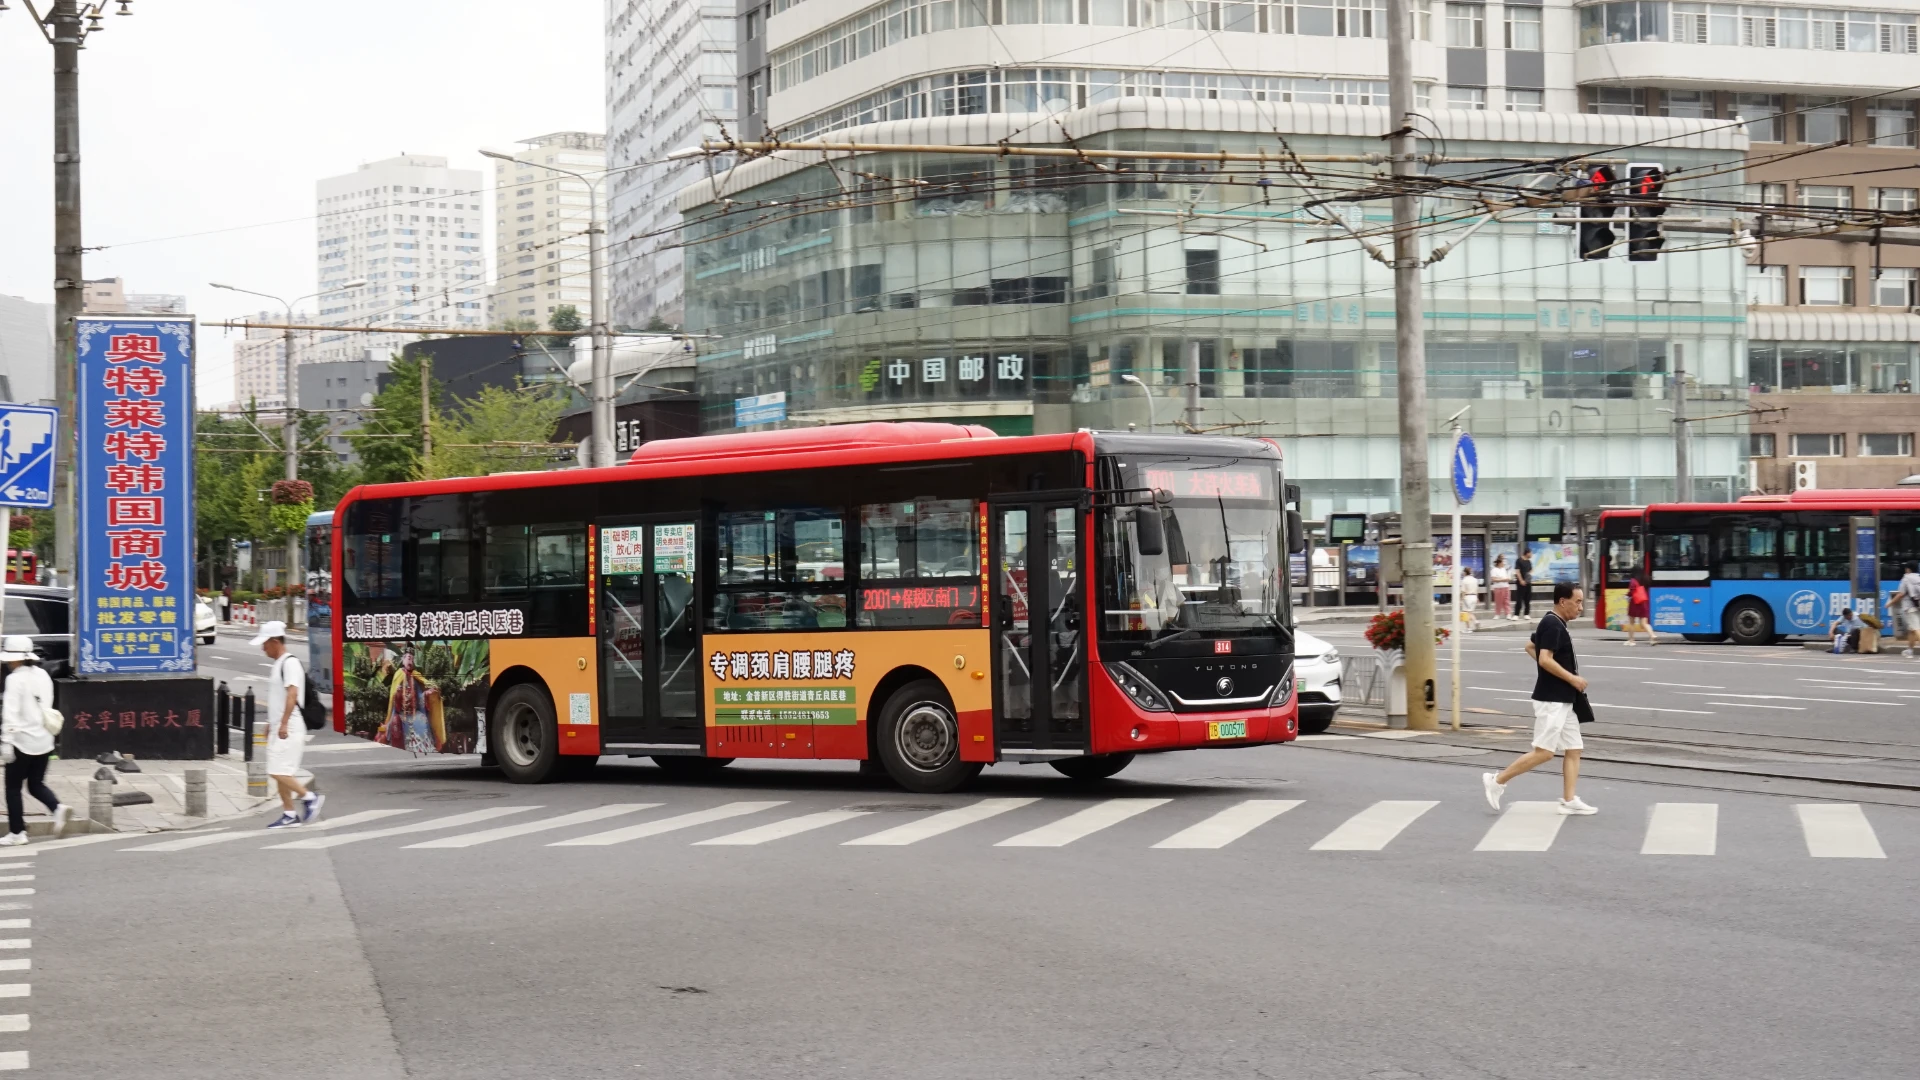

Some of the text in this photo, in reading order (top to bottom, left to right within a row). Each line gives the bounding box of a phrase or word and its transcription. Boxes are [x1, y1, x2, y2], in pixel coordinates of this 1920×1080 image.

[888, 354, 1024, 385] 中国邮政
[104, 333, 168, 591] 奥特莱特韩国商城
[25, 487, 48, 500] 20m
[616, 543, 642, 555] 放心肉
[863, 588, 891, 610] 2001
[97, 610, 177, 625] 批发零售
[346, 609, 525, 639] 颈肩腰腿疼 就找青丘良医巷
[113, 644, 160, 654] 地下一层
[1216, 642, 1230, 652] 314
[710, 649, 856, 680] 专调颈肩腰腿疼
[1195, 663, 1258, 671] YUTONG
[73, 709, 204, 731] 宏孚国际大厦
